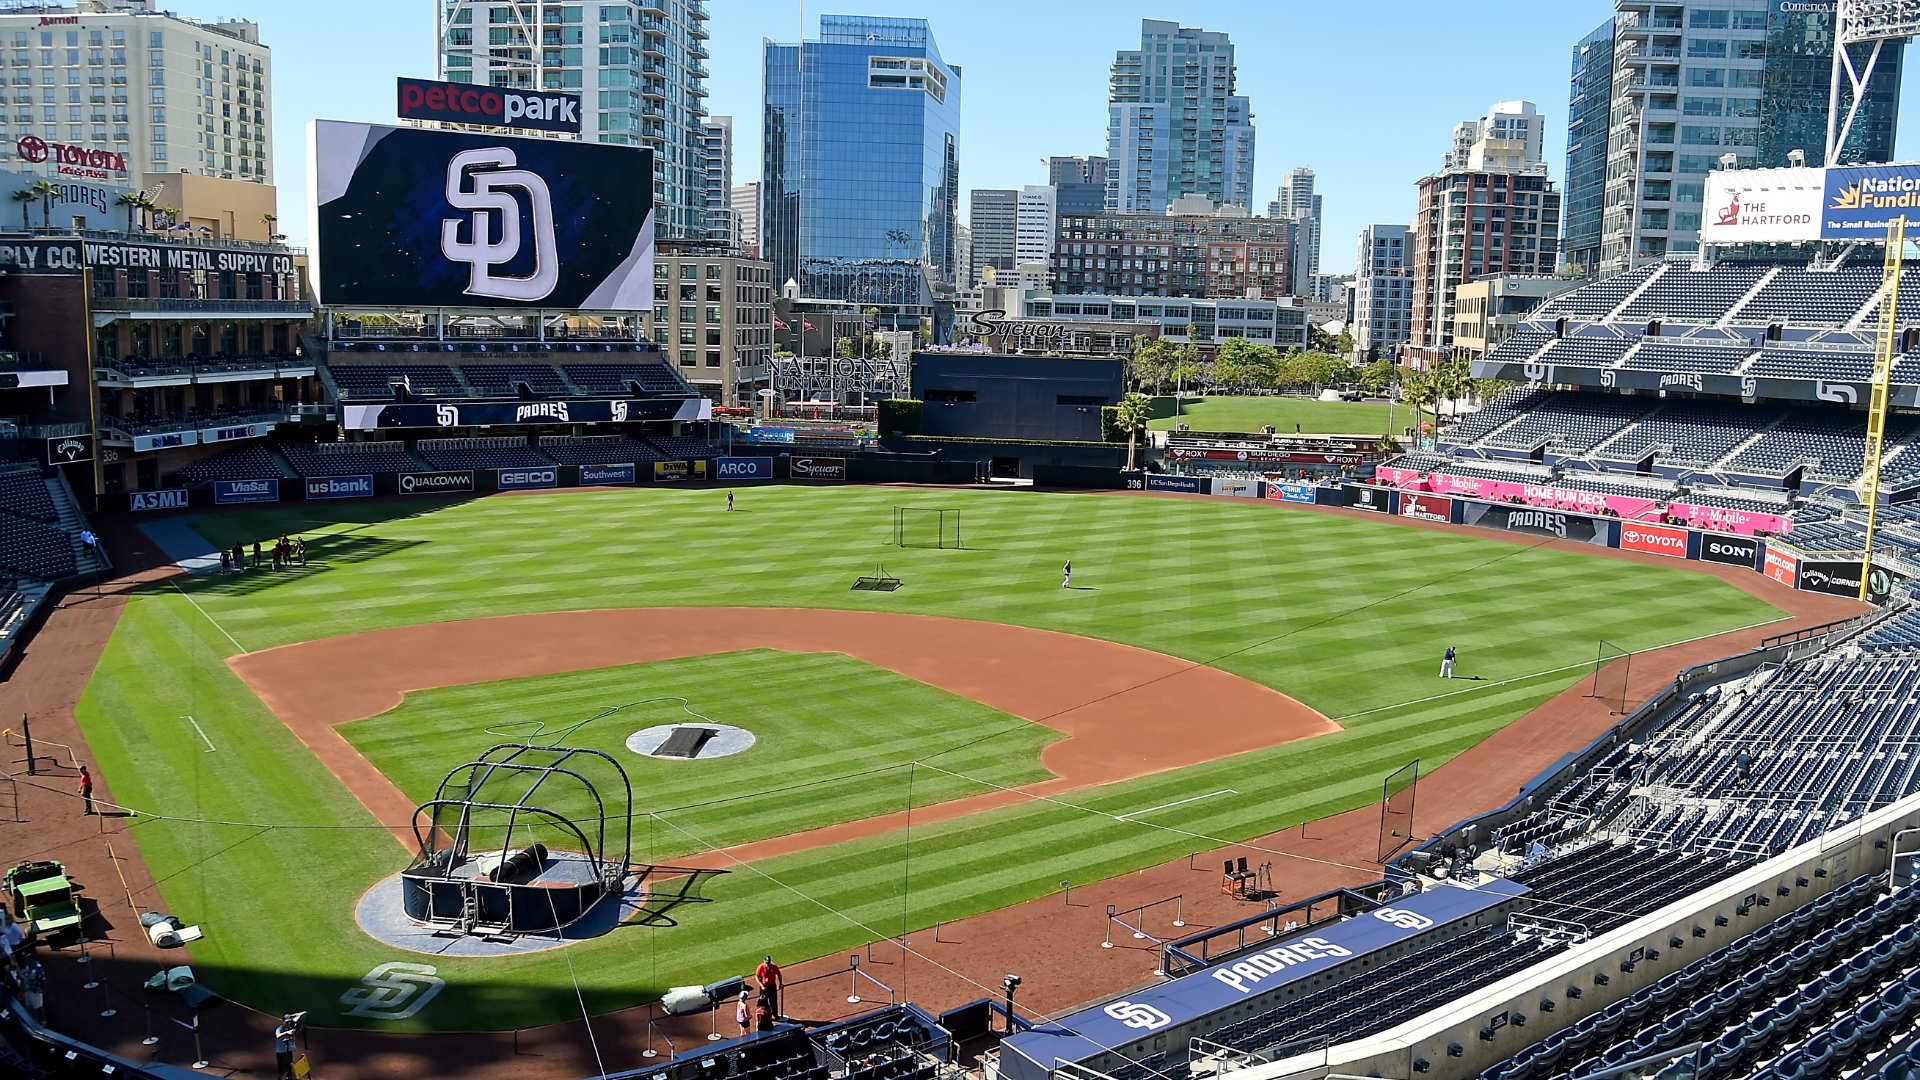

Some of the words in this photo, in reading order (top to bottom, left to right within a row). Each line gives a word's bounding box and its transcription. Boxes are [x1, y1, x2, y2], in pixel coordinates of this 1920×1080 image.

[52, 143, 127, 172] TOYOTA
[51, 183, 106, 214] PADRES
[1744, 202, 1766, 212] THE
[1742, 214, 1811, 225] HARTFORD
[1828, 221, 1841, 229] The
[1843, 220, 1862, 229] Small
[46, 246, 83, 269] CO.
[85, 244, 160, 267] WESTERN
[168, 249, 215, 270] METAL
[218, 253, 267, 273] SUPPLY
[272, 257, 294, 275] CO.
[969, 309, 1067, 344] Sycuan
[775, 375, 905, 393] UNIVERSITY
[1660, 374, 1703, 391] PADRES
[516, 401, 570, 422] PADRES
[1186, 450, 1208, 458] ROXY
[1336, 456, 1360, 464] ROXY
[583, 470, 625, 479] Southwest
[719, 462, 757, 475] ARCO
[794, 459, 844, 477] Sycuan
[402, 475, 470, 491] QUALCOMM
[501, 471, 555, 484] GEICO
[1127, 480, 1142, 489] 396
[231, 481, 269, 492] ViaSat
[132, 491, 187, 509] ASML
[1523, 486, 1554, 500] HOME
[1555, 490, 1577, 502] RUN
[1578, 493, 1607, 506] DECK
[1415, 512, 1446, 521] HARTFORD
[1507, 511, 1567, 539] PADRES
[1640, 533, 1684, 549] TOYOTA
[1709, 543, 1755, 559] SONY
[1766, 552, 1796, 572] petco.com
[1802, 570, 1829, 583] Callaway
[1831, 577, 1861, 588] CORNER
[1211, 937, 1353, 994] PADRES
